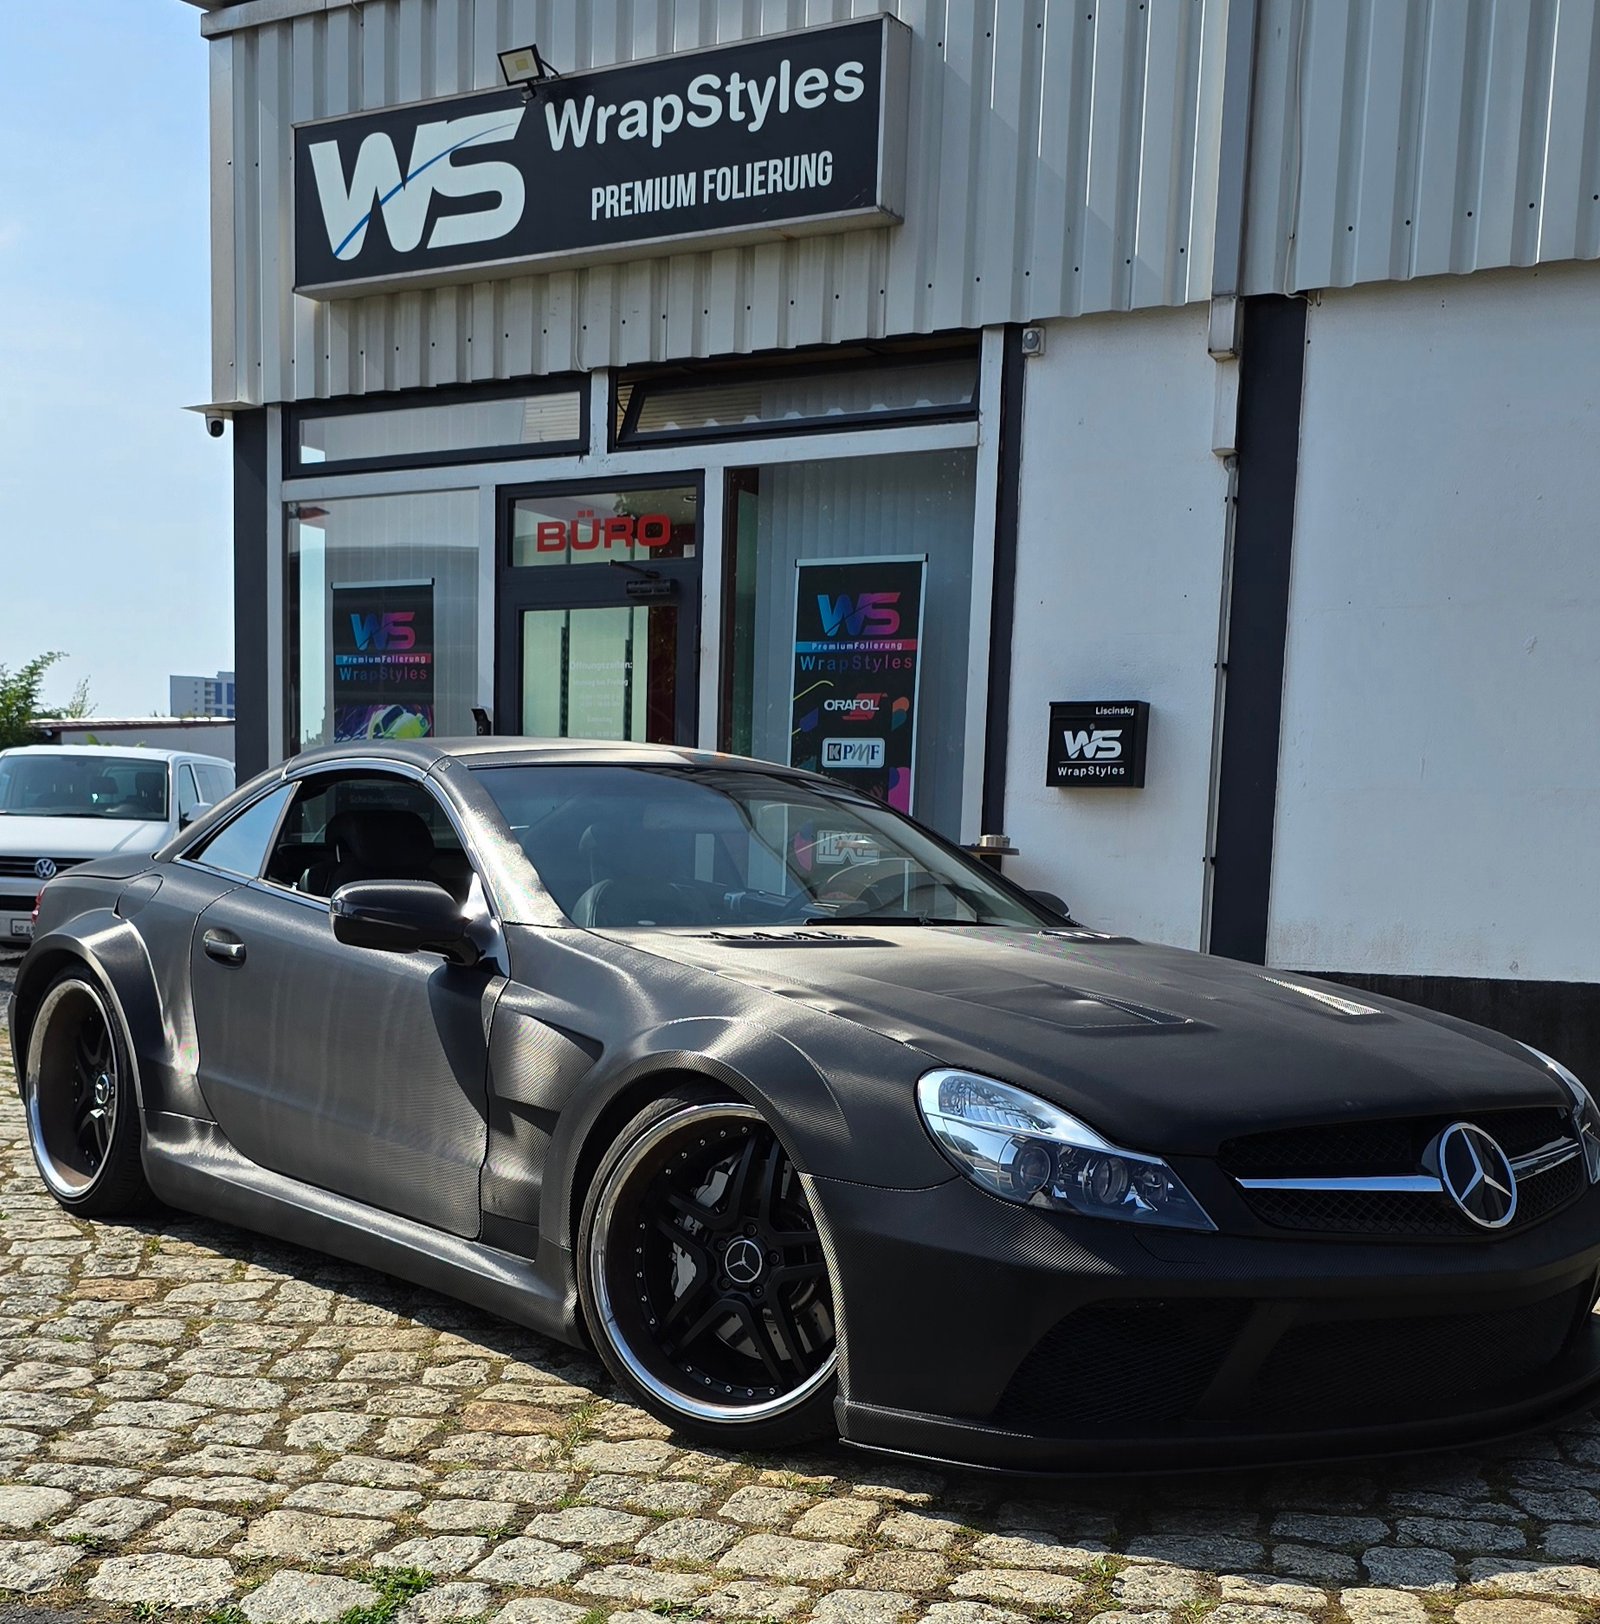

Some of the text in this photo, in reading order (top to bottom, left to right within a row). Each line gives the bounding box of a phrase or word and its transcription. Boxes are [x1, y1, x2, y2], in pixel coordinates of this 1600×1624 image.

[545, 59, 865, 151] WrapStyles
[309, 106, 526, 261] WS
[591, 150, 834, 221] PREMIUM FOLIERUNG
[536, 510, 672, 552] BÜRO
[816, 592, 901, 637] WS
[350, 611, 416, 651] WS
[811, 641, 903, 651] PremiumFolierung
[340, 666, 428, 683] WrapStyles
[800, 654, 913, 673] WrapStyles
[823, 699, 880, 711] ORAFOL
[827, 742, 881, 764] KPMF
[1063, 729, 1123, 759] WS
[1057, 765, 1125, 777] WrapStyles
